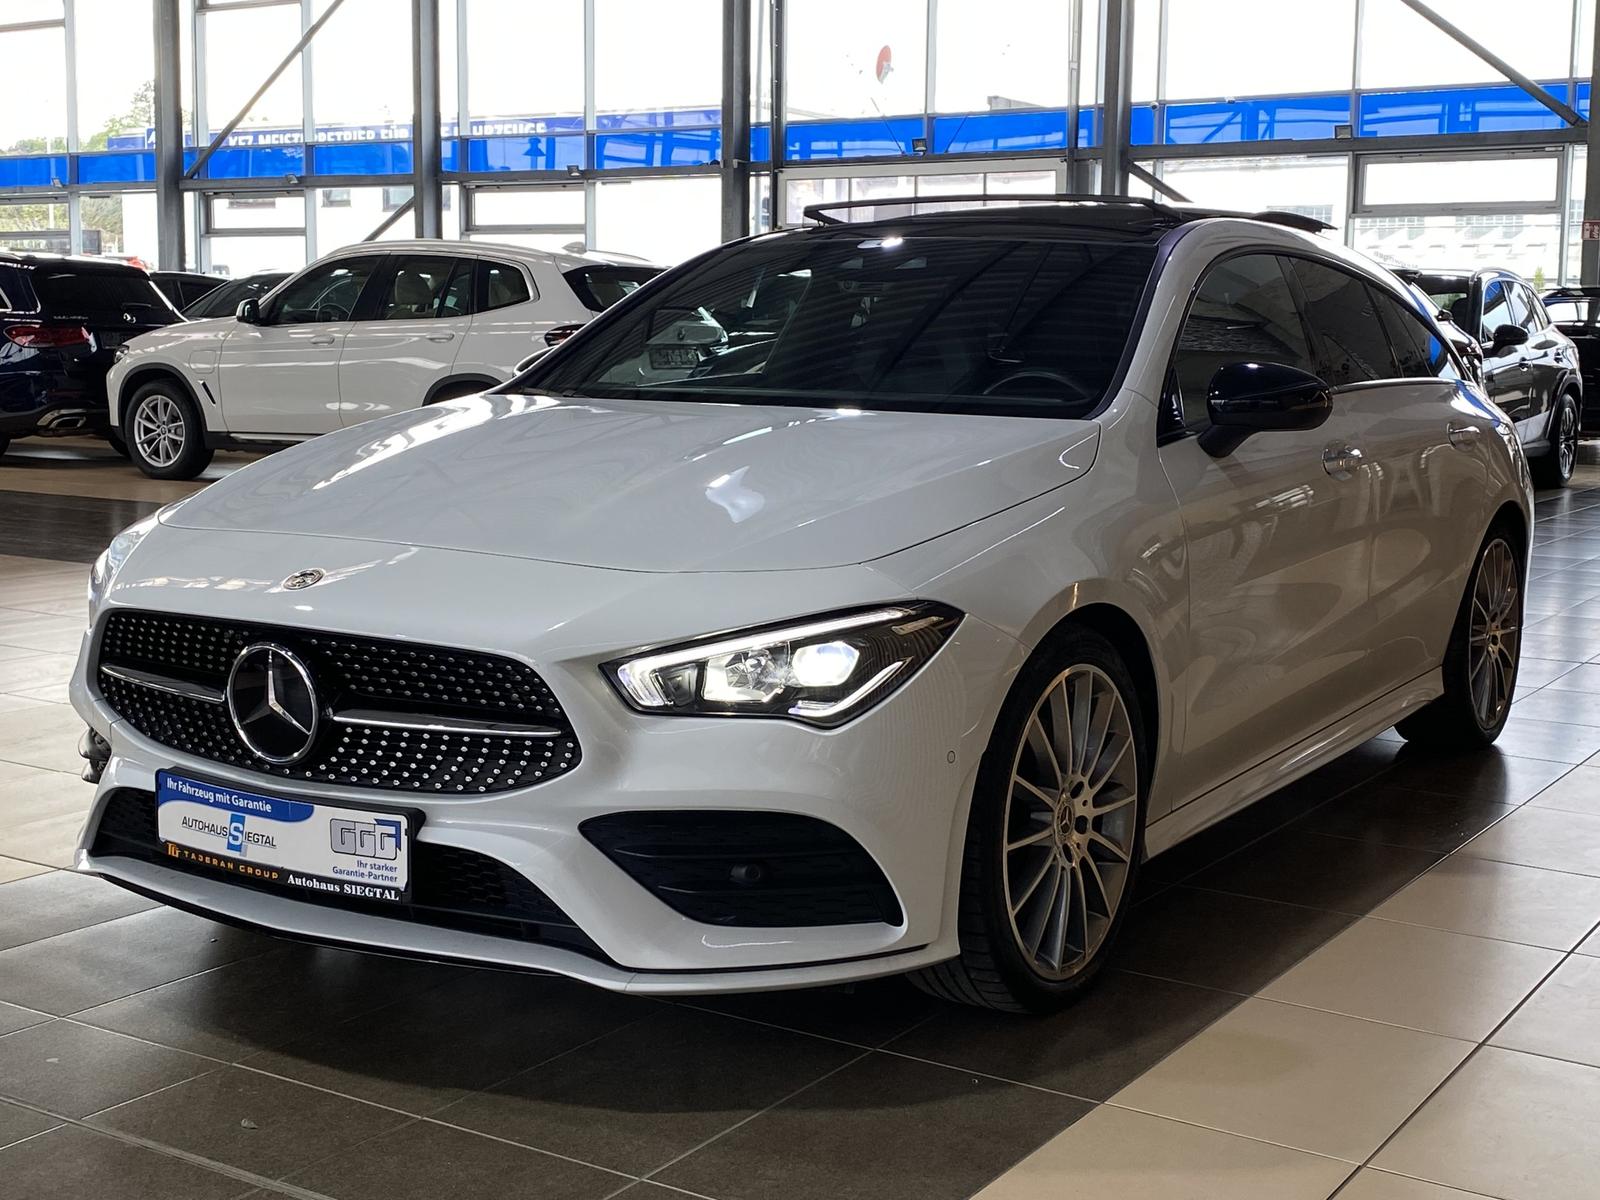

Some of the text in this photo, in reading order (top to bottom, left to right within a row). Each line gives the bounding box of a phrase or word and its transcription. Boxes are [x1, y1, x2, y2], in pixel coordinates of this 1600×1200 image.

[166, 777, 272, 812] Ihr Fahrzeug mit Garantie
[181, 816, 228, 837] AUTOHAUS
[239, 864, 278, 880] GROUP
[332, 866, 398, 883] Garantie-Partner
[356, 860, 398, 873] Ihr starker
[287, 873, 400, 901] Autohaus SIEGTAL
